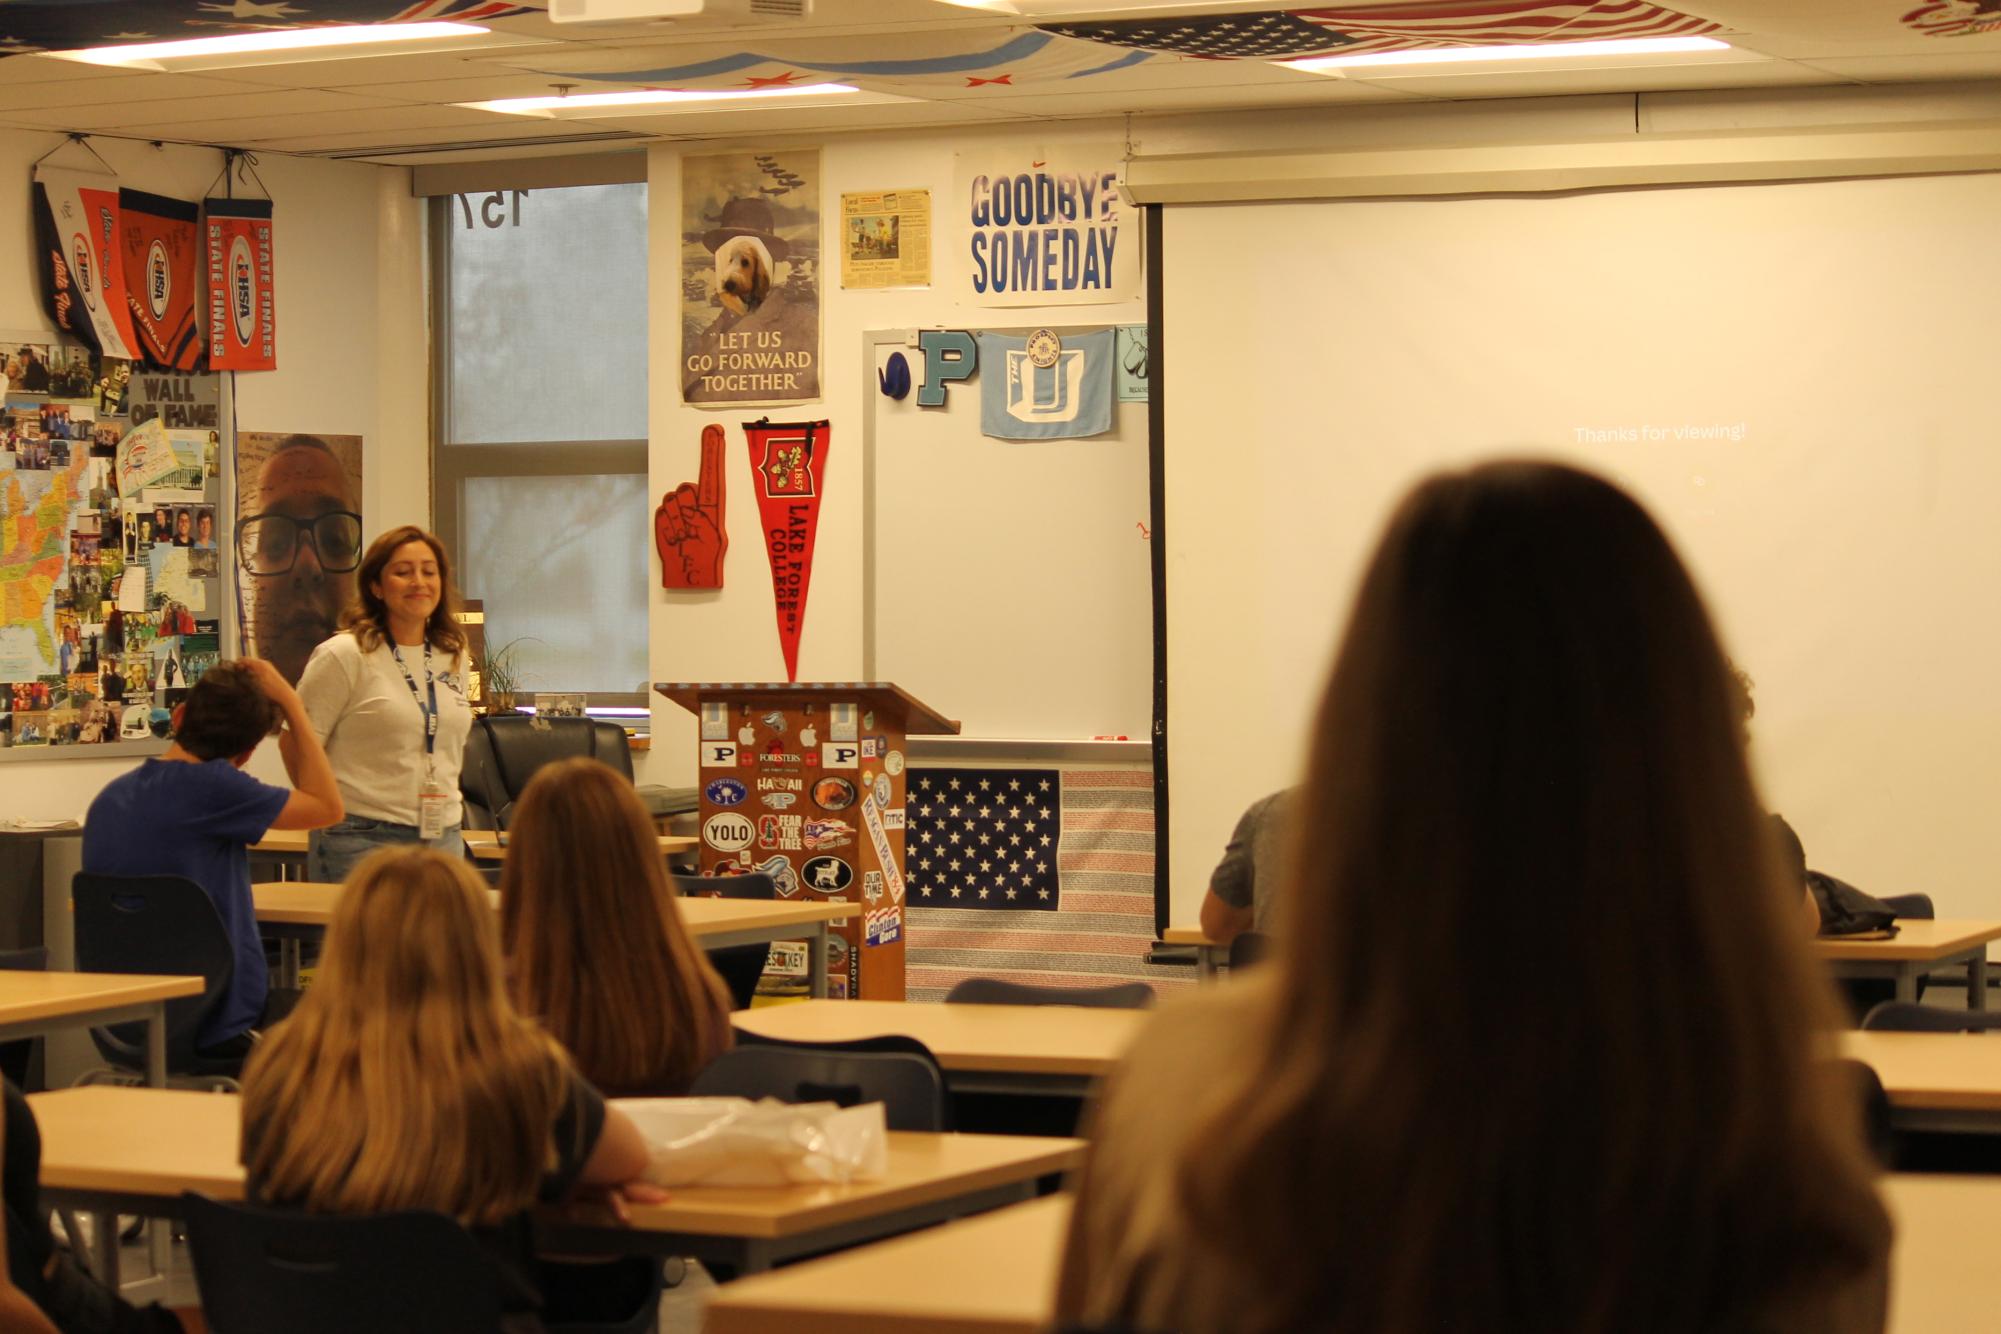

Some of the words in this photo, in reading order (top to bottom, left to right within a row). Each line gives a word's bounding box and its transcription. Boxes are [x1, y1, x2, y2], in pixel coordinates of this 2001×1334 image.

[971, 172, 1119, 227] GOODBYE
[210, 226, 224, 283] STATE
[259, 227, 272, 284] STATE
[971, 226, 1118, 294] SOMEDAY
[154, 258, 165, 300] IHSA
[237, 263, 250, 319] IHSA
[213, 289, 226, 357] FINALS
[261, 290, 273, 358] FINALS
[757, 331, 782, 349] US
[687, 354, 713, 372] GO
[718, 351, 812, 371] FORWARD
[917, 329, 979, 407] P
[1011, 355, 1020, 385] THE
[143, 378, 195, 402] WALL
[1007, 349, 1085, 423] U
[131, 404, 159, 427] OF
[164, 404, 217, 427] FAME
[1574, 426, 1638, 444] Thanks
[1642, 424, 1670, 441] for
[1673, 422, 1746, 442] viewing!
[794, 467, 804, 492] 1857
[789, 504, 809, 553] LAKE
[770, 528, 787, 612] COLLEGE
[787, 561, 804, 635] FOREST
[714, 747, 735, 761] P
[759, 753, 801, 762] FORESTERS
[835, 748, 857, 763] P
[711, 825, 748, 841] YOLO
[778, 815, 802, 827] FEAR
[781, 827, 800, 838] THE
[779, 838, 802, 850] TREE
[864, 883, 882, 896] TIME
[865, 872, 881, 884] OUR
[868, 917, 897, 937] Clinton
[879, 928, 897, 944] Gore
